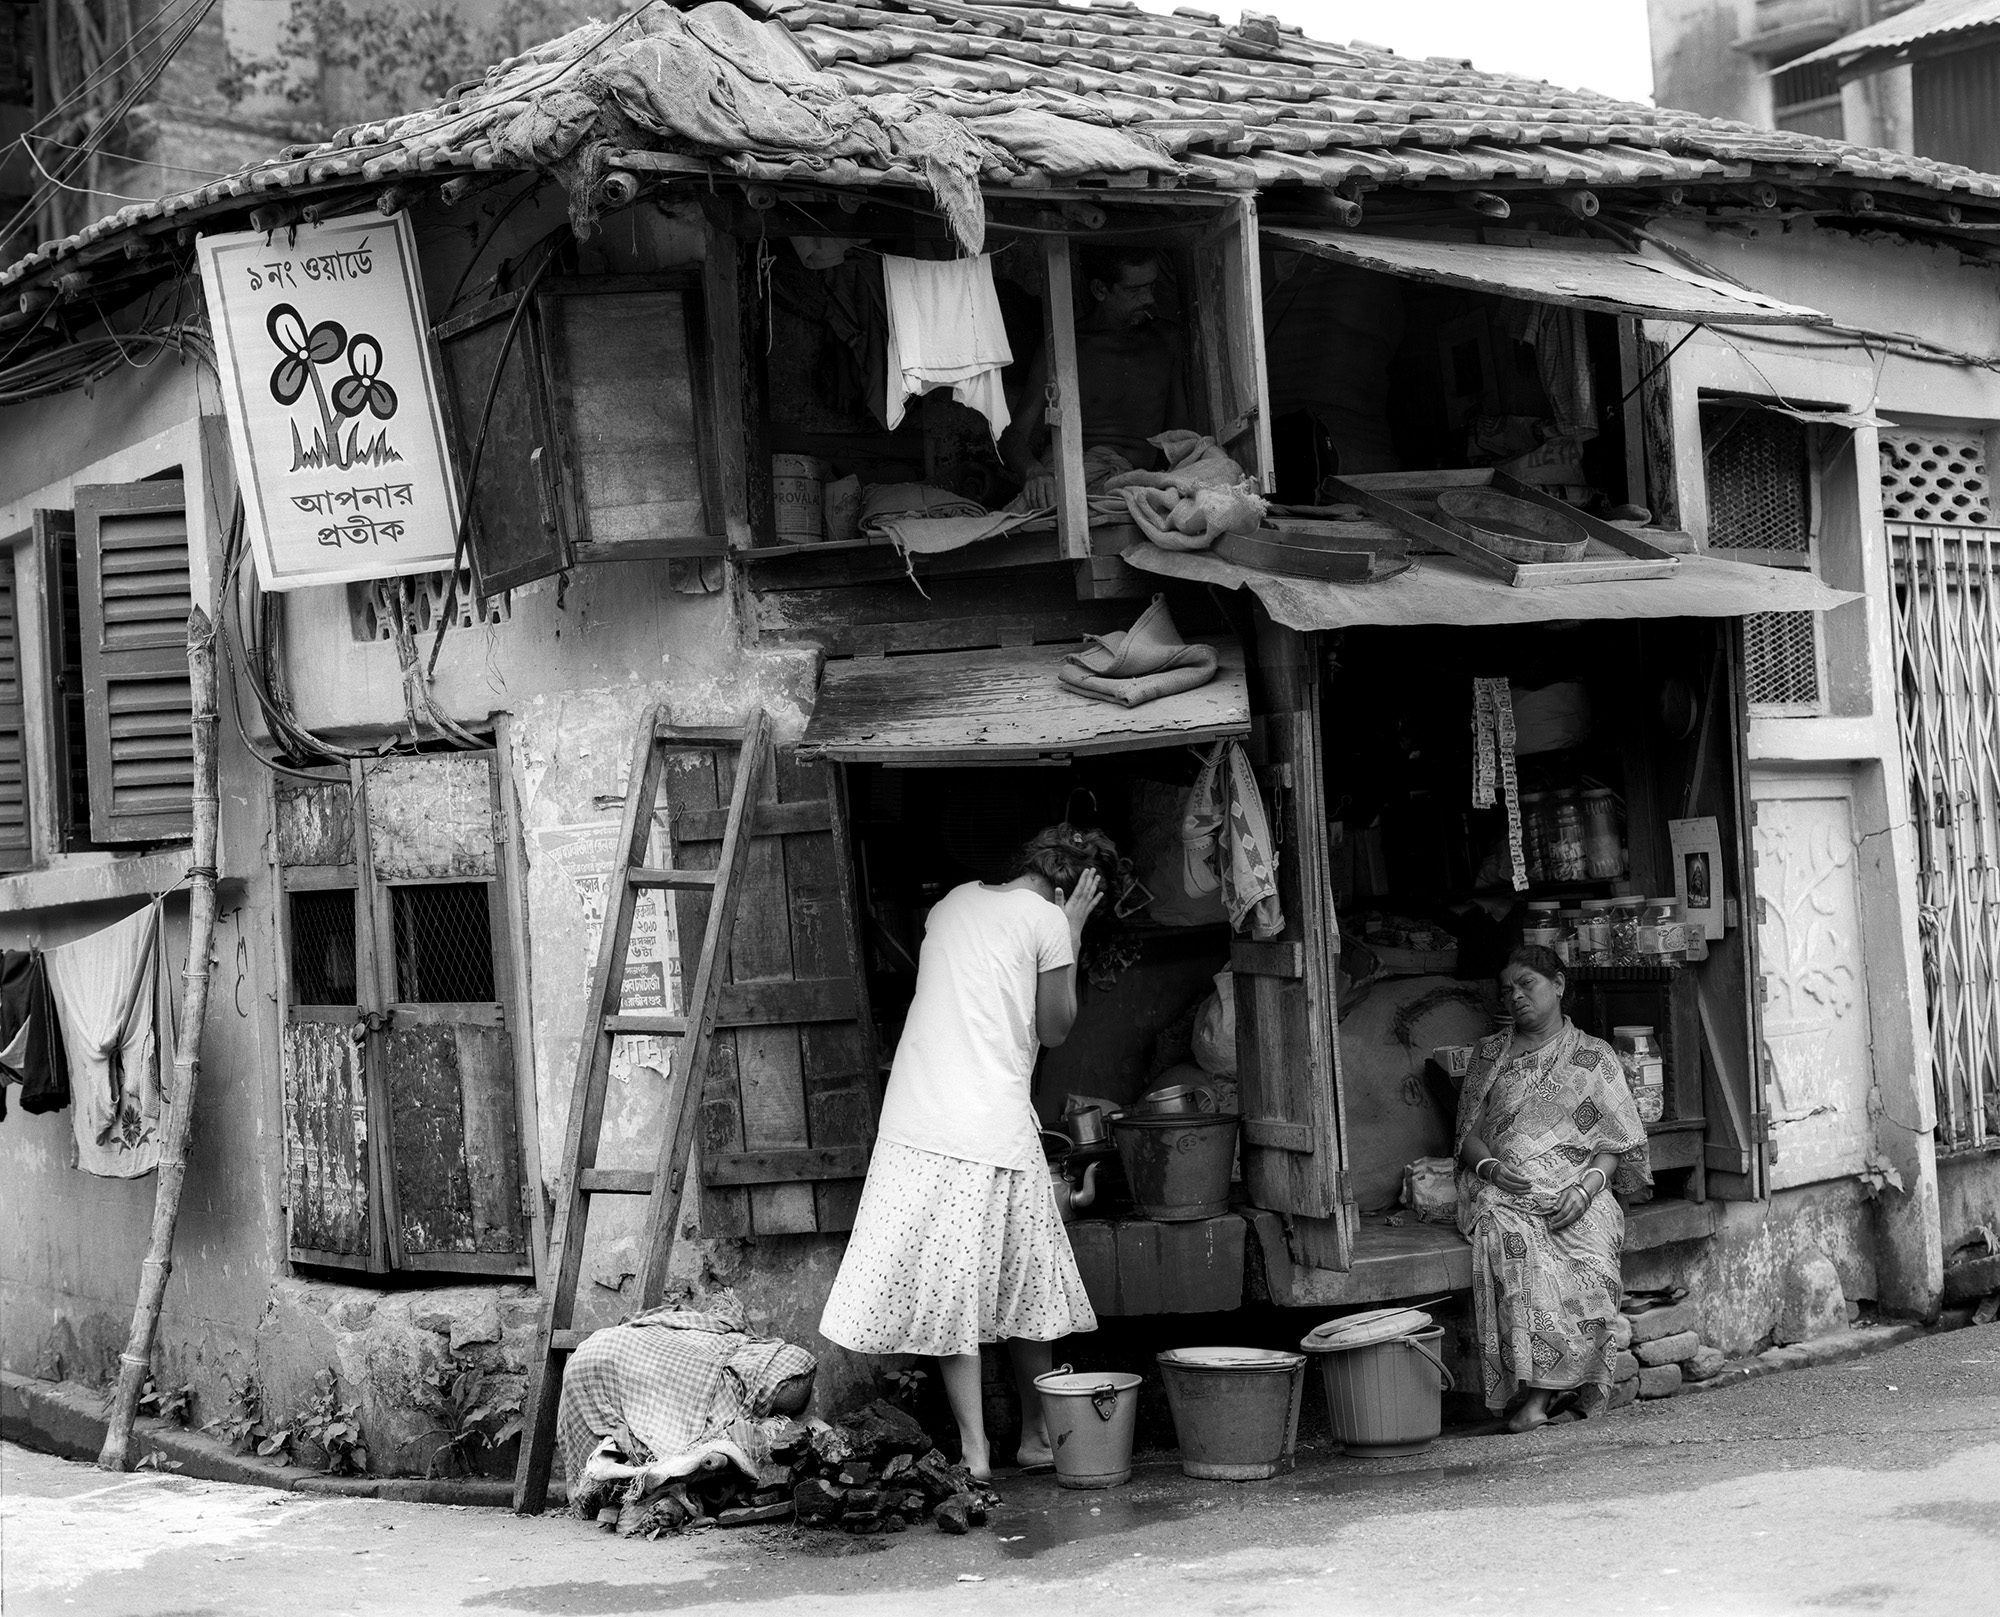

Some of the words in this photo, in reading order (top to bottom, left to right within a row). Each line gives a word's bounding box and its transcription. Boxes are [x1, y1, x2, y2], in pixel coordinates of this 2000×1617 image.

[300, 236, 373, 281] ওয়ার্ডে
[289, 483, 414, 516] আপনার
[317, 515, 405, 549] প্রতীক
